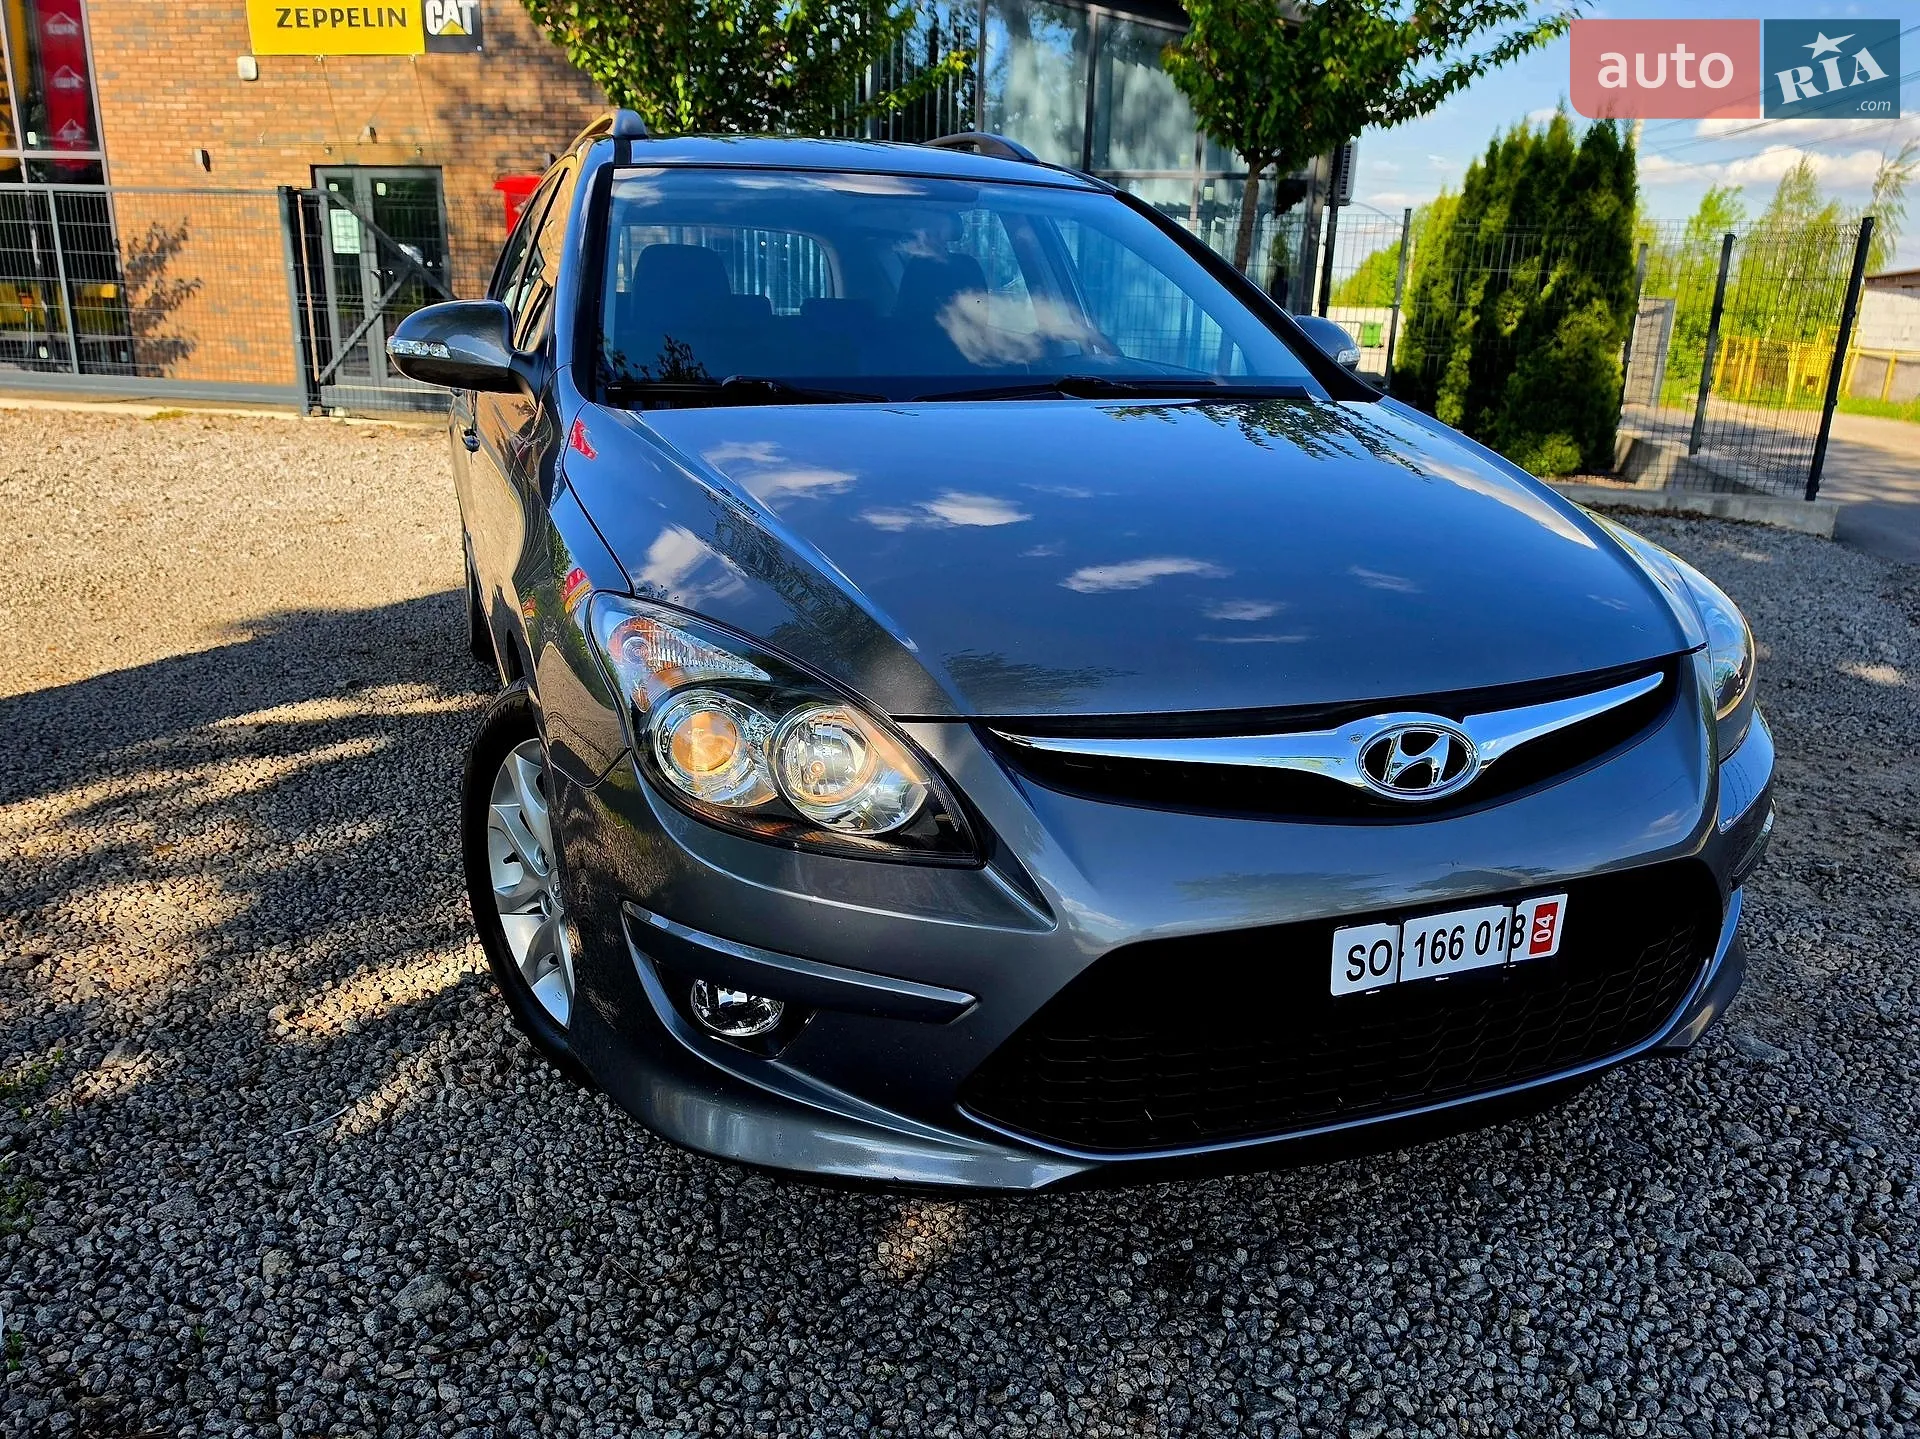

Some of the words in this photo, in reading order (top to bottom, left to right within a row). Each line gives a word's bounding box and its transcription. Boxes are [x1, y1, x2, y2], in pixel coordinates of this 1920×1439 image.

[275, 8, 407, 28] ZEPPELIN
[425, 0, 475, 35] CAT
[1533, 913, 1554, 944] 04
[1346, 939, 1392, 982] SO
[1414, 925, 1465, 968] 166
[1475, 914, 1525, 956] 018
